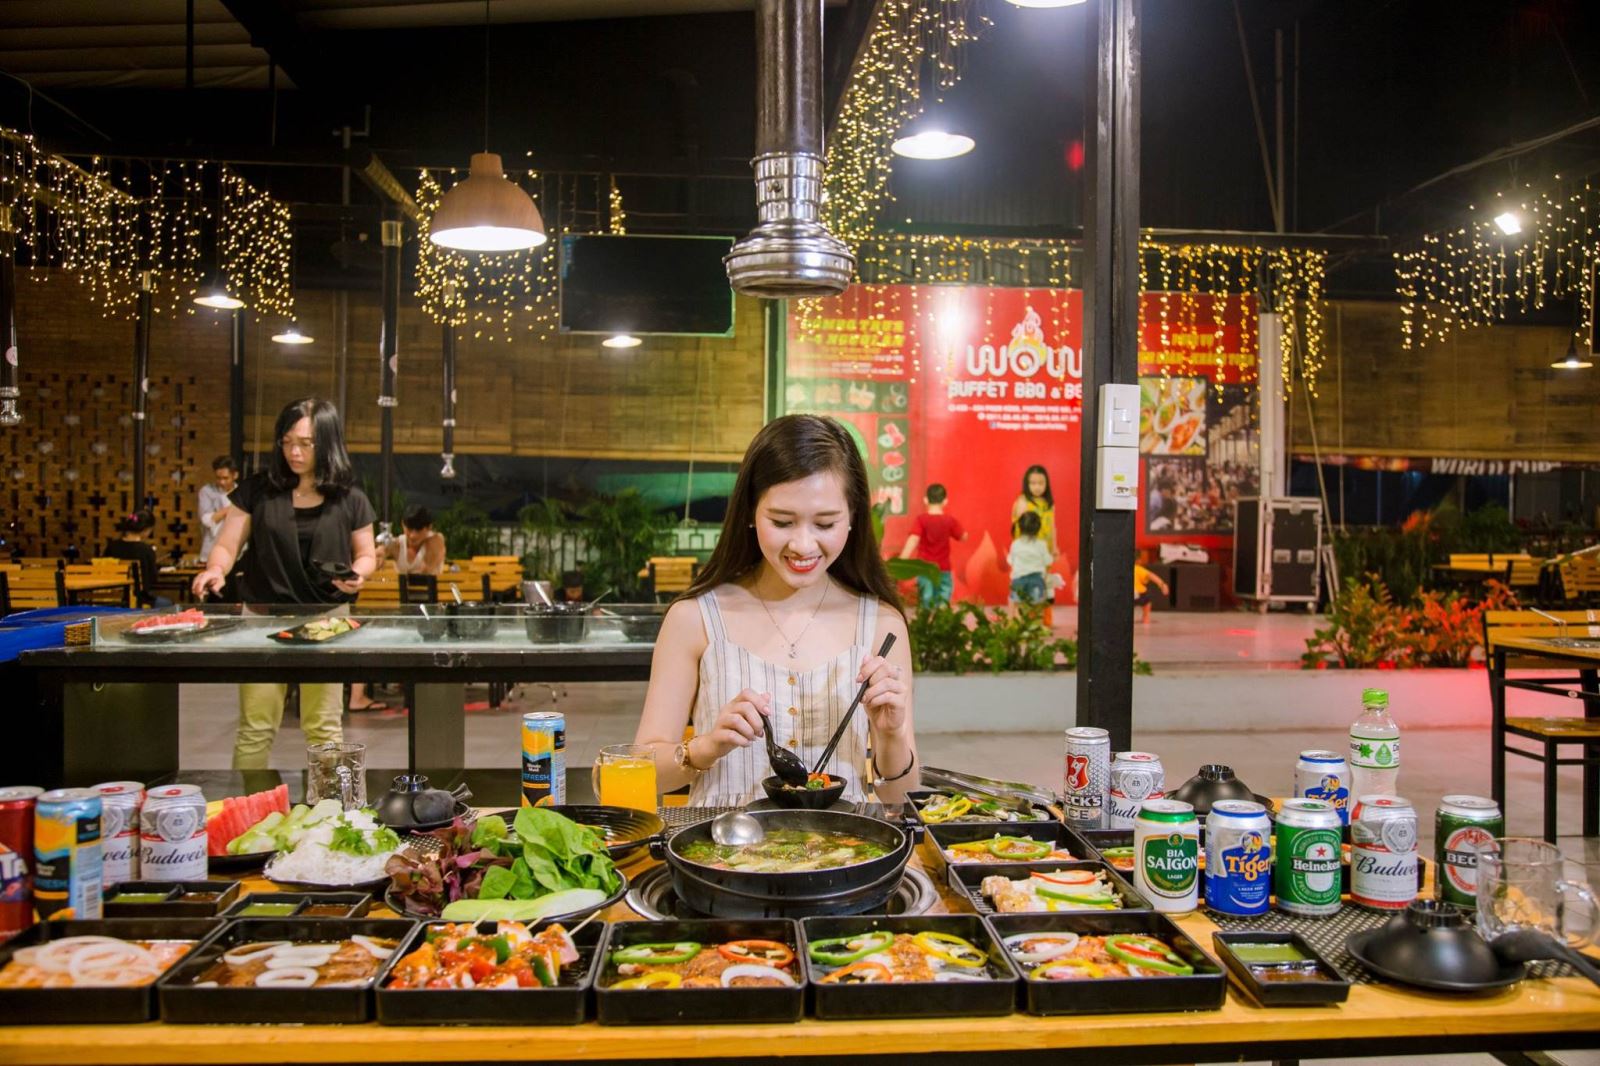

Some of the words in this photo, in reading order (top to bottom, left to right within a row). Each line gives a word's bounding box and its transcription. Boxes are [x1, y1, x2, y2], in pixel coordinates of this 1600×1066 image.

[948, 380, 1008, 399] BUFFET
[1014, 381, 1046, 399] BBQ
[1167, 849, 1185, 857] BIA
[1147, 855, 1197, 871] SAIGON
